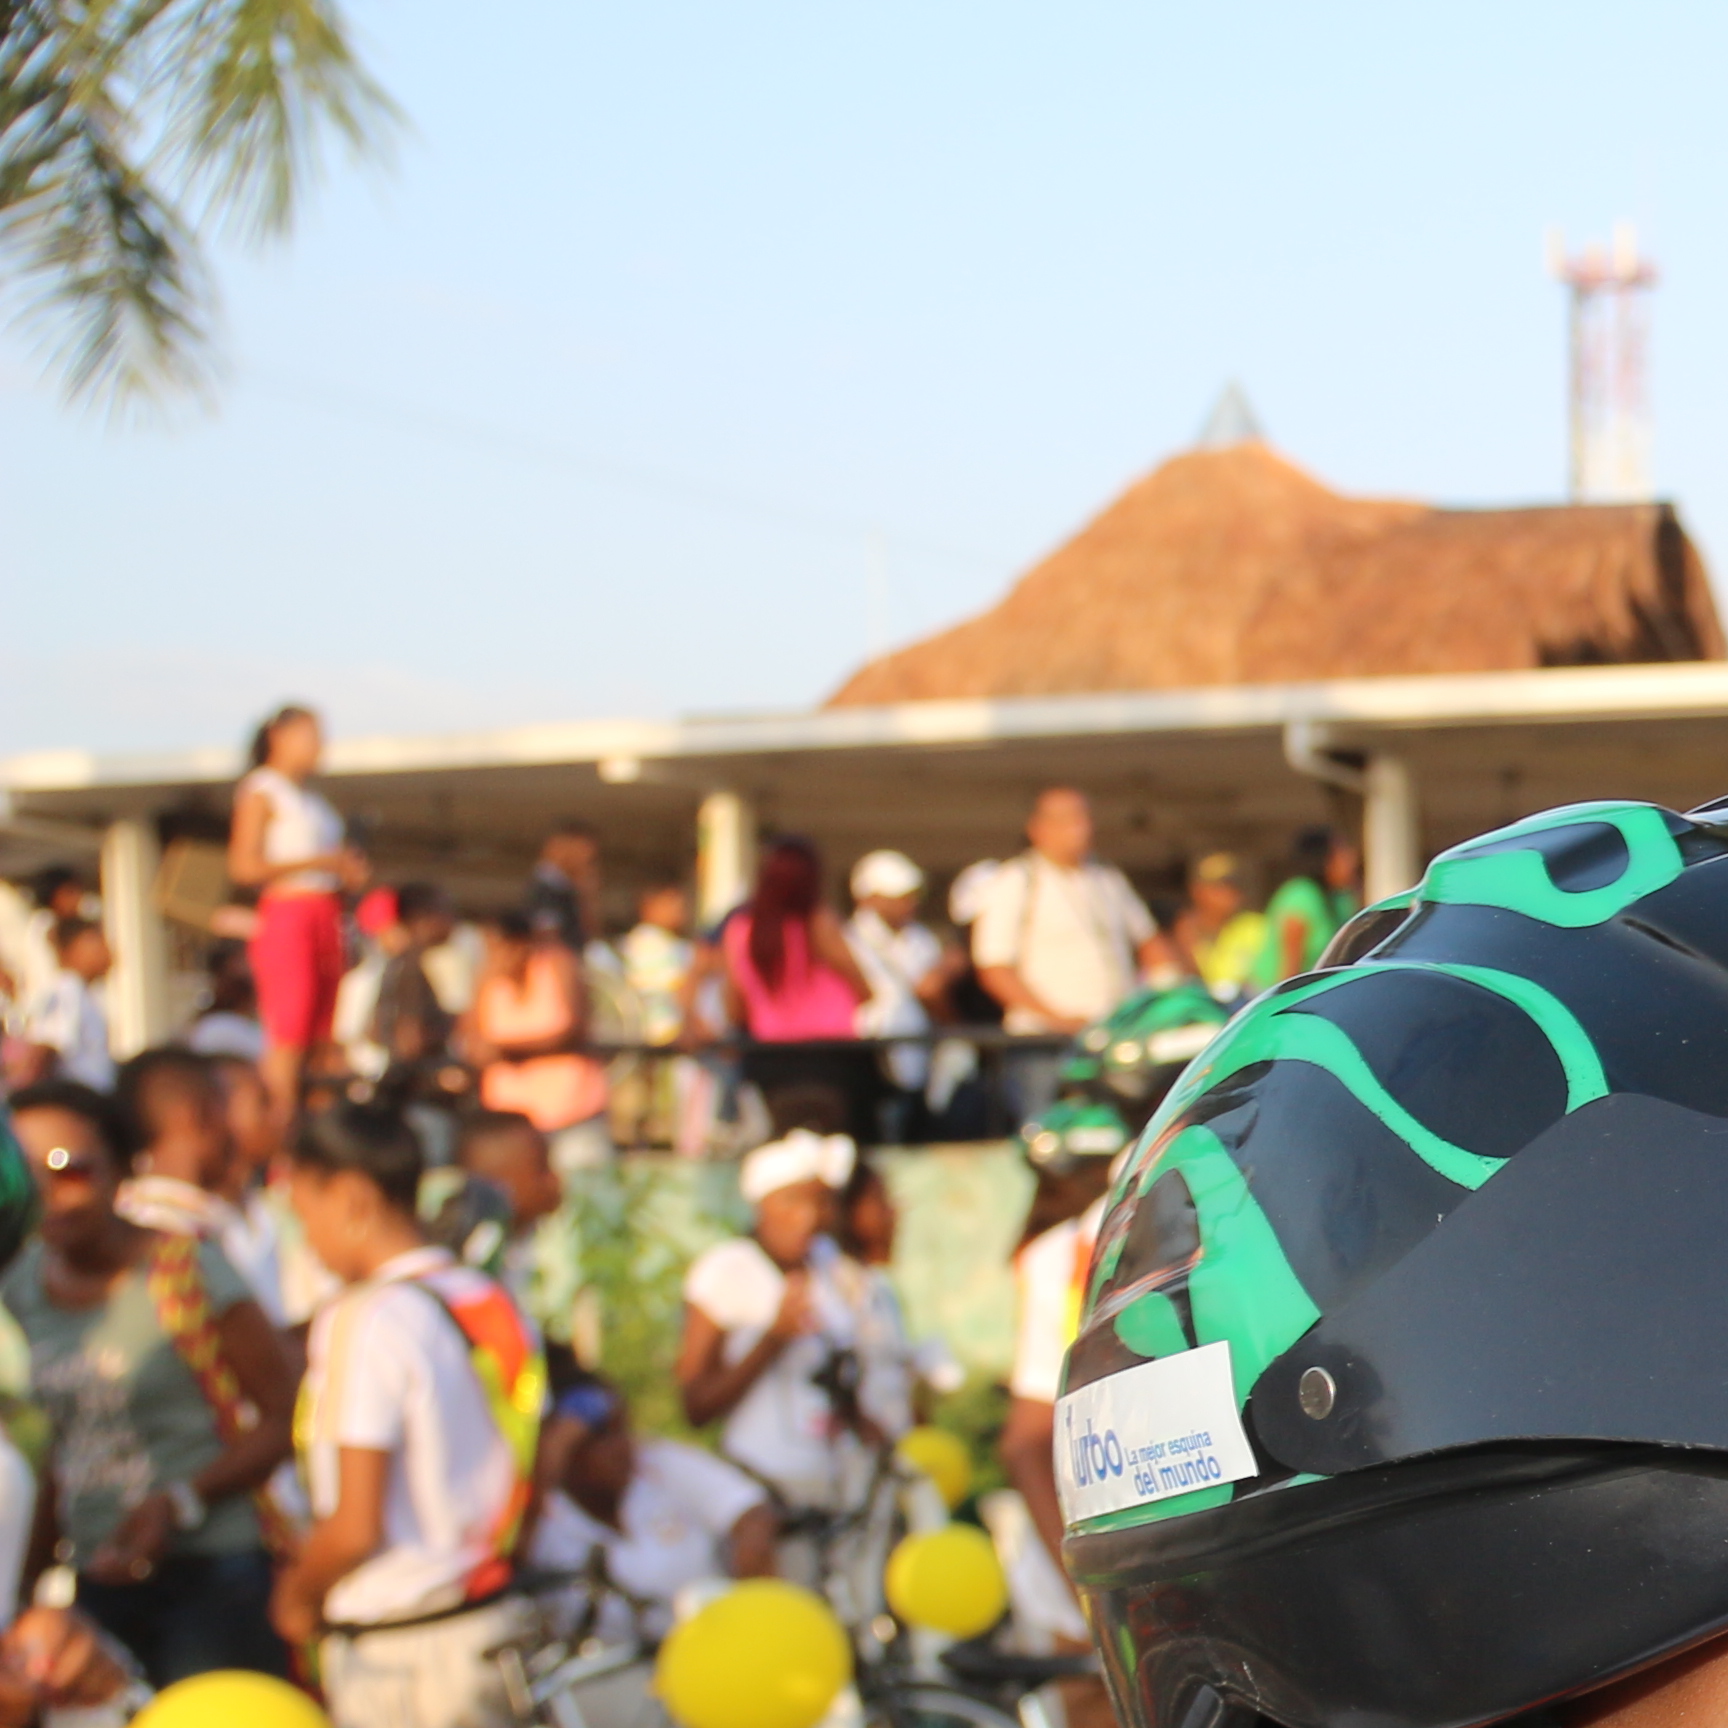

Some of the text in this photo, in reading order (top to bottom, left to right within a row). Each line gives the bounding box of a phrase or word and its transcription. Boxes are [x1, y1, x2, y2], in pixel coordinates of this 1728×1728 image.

[1065, 1404, 1124, 1488] Turbo
[1124, 1430, 1213, 1466] La mejor esquina
[1134, 1451, 1222, 1496] del mundo
